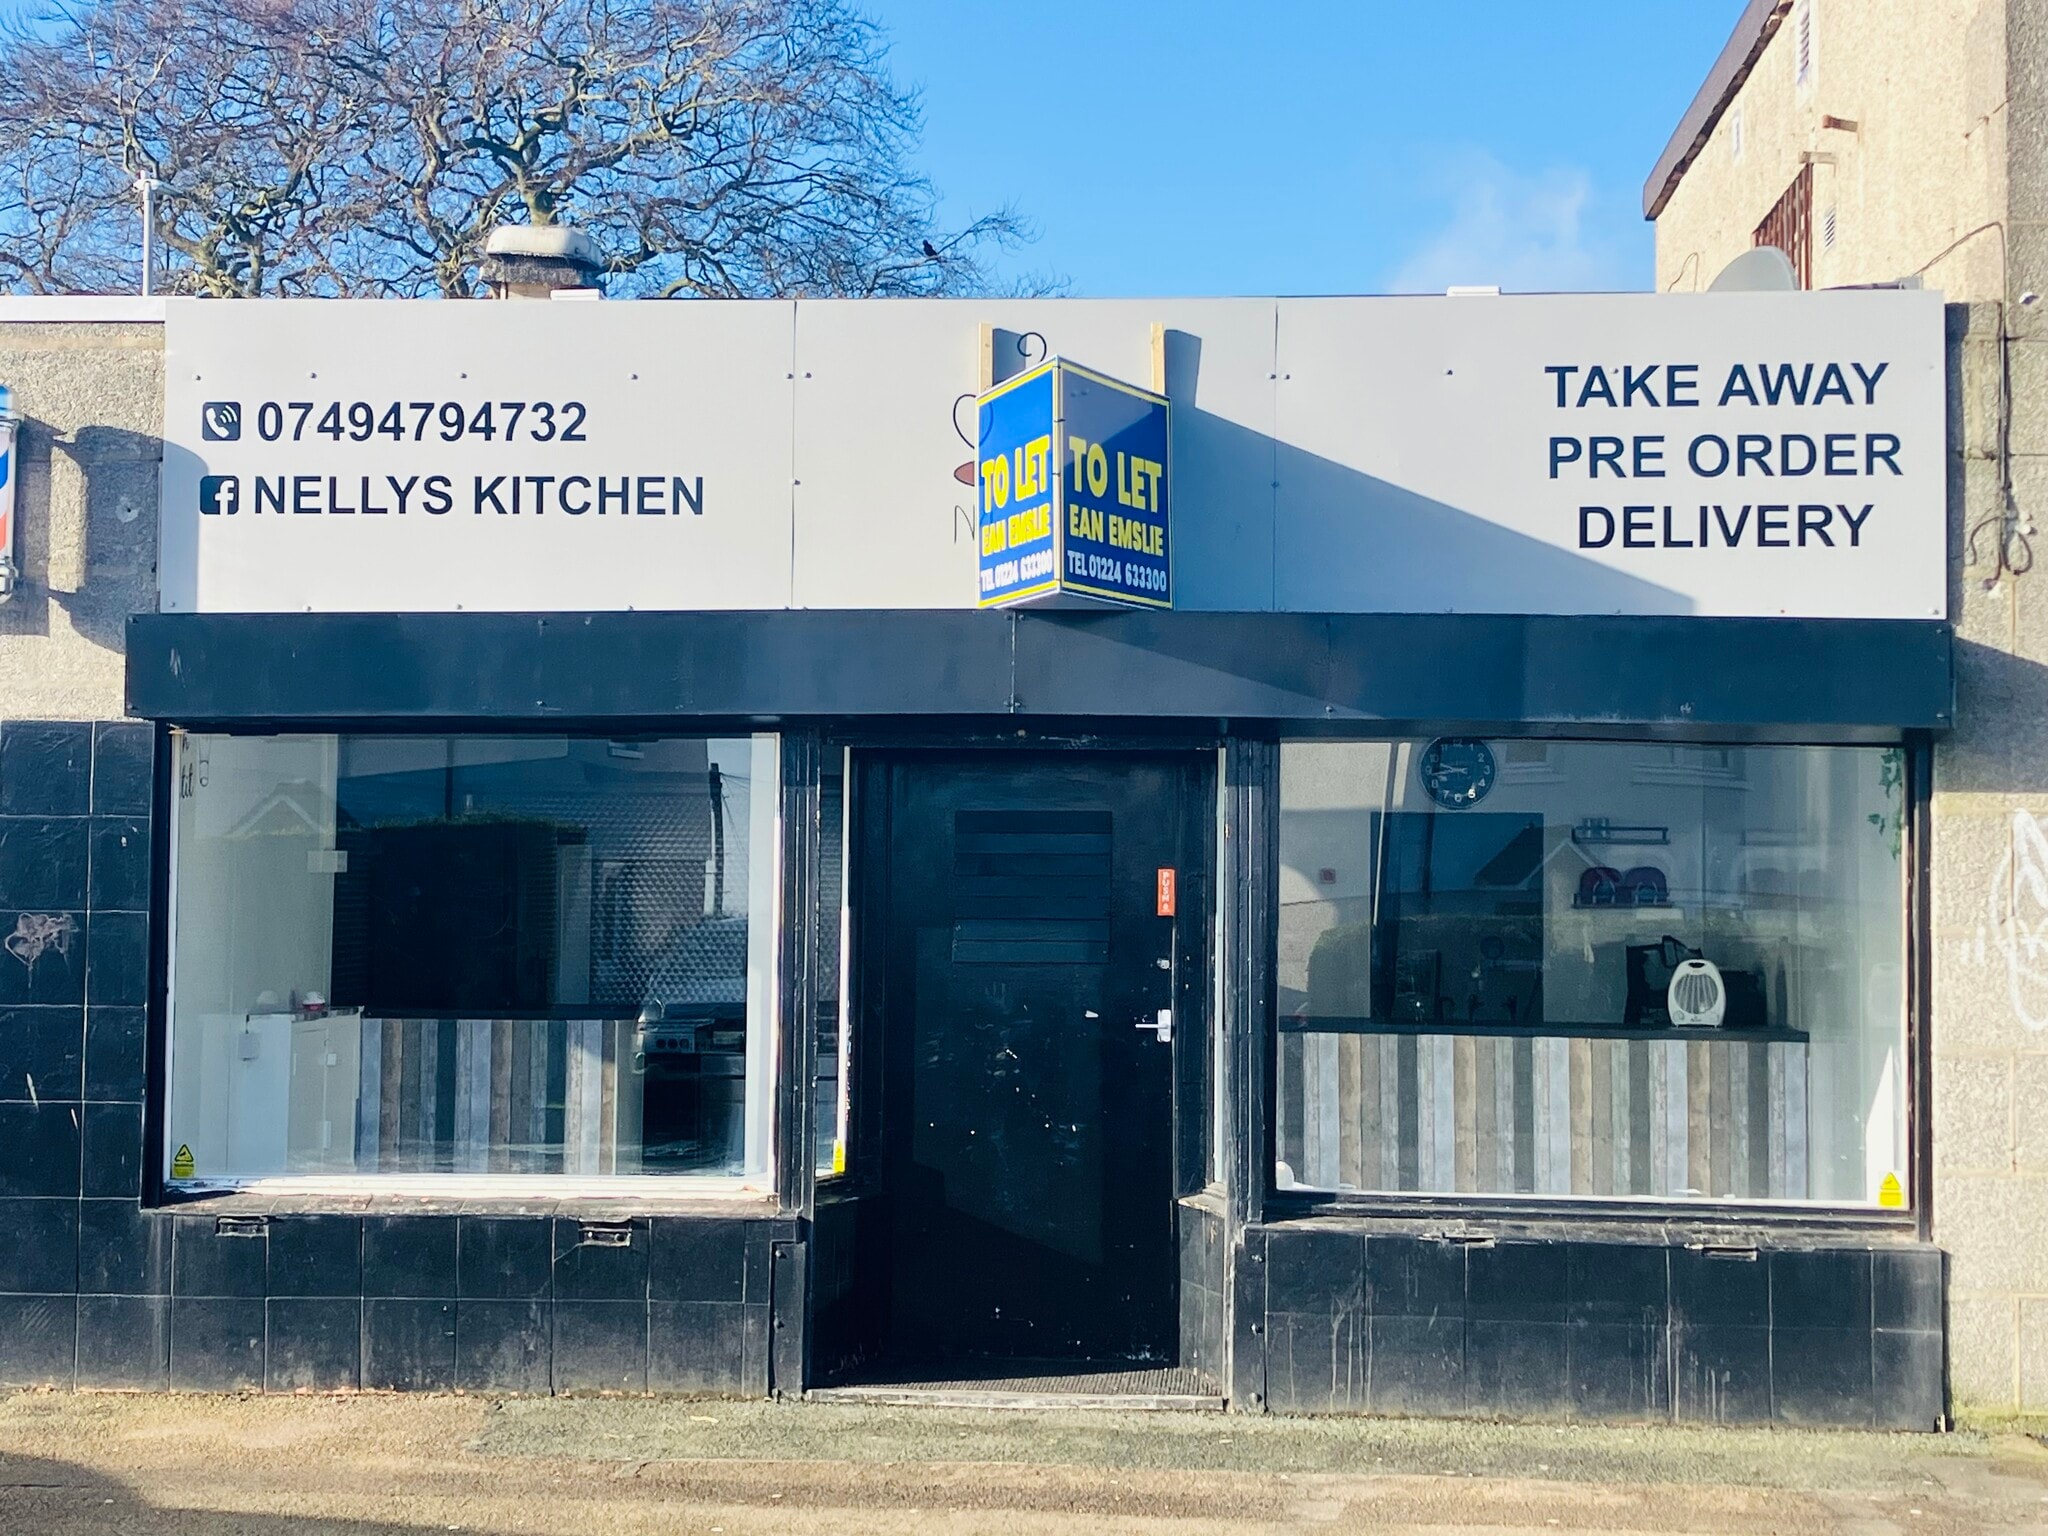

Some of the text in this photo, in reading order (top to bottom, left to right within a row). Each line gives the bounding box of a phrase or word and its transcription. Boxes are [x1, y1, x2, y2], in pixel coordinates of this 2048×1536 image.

[1544, 362, 1889, 408] TAKE AWAY
[257, 401, 587, 442] 07494794732
[981, 434, 1050, 513] TO LET
[1069, 436, 1162, 513] TO LET
[1549, 433, 1904, 479] PRE ORDER
[254, 475, 703, 516] NELLYS KITCHEN
[982, 519, 1007, 557] EAN
[1008, 502, 1051, 548] EMSLIE
[1069, 503, 1164, 557] EAN EMSLIE
[1578, 504, 1874, 549] DELIVERY
[1067, 549, 1167, 592] TEL 01224 633300
